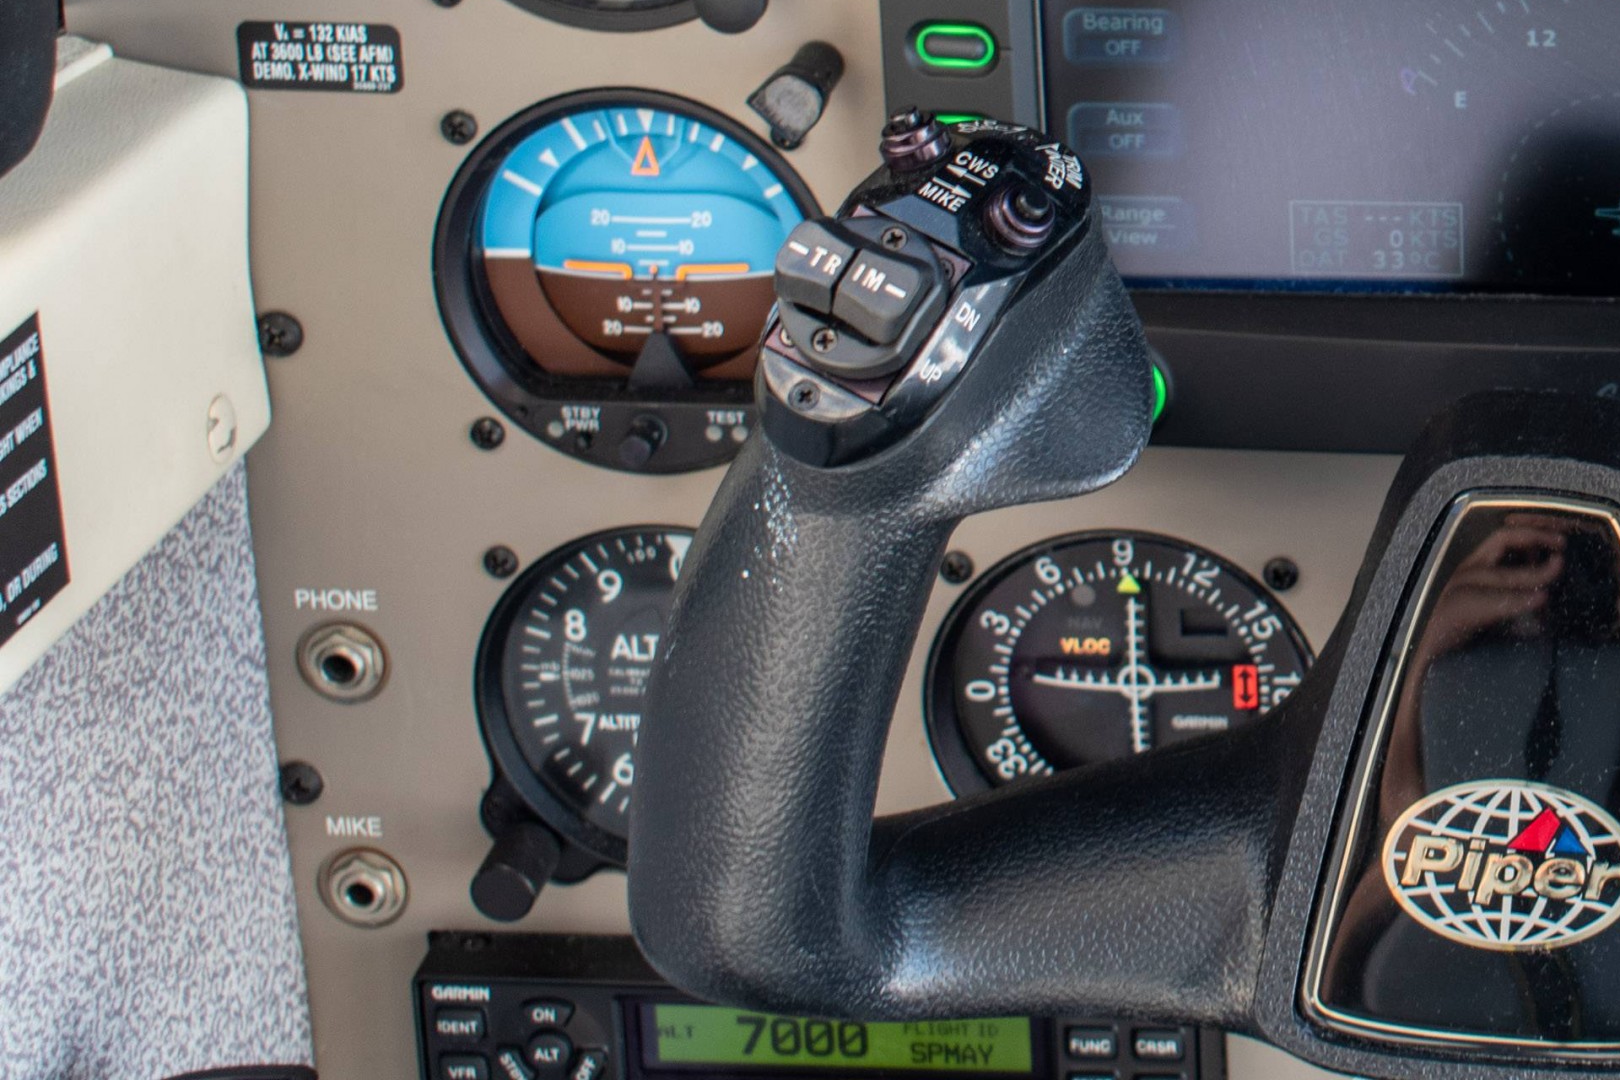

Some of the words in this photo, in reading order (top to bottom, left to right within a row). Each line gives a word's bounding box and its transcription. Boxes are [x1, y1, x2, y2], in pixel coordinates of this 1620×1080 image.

[309, 26, 333, 42] 132
[336, 26, 367, 43] KIAS
[1082, 15, 1163, 34] Bearing
[1106, 41, 1141, 55] OFF
[1527, 31, 1556, 47] 12
[253, 62, 295, 80] DEMO.
[299, 64, 348, 82] X-WIND
[352, 65, 366, 81] 17
[372, 65, 396, 83] KTS
[1107, 111, 1143, 125] Aux
[955, 152, 999, 179] CWS
[919, 181, 966, 212] MIKE
[591, 210, 609, 225] 20
[692, 212, 711, 226] 20
[956, 303, 980, 331] DN
[603, 321, 622, 335] 20
[703, 323, 723, 337] 20
[1112, 540, 1133, 565] 9
[1035, 557, 1061, 584] 6
[1181, 553, 1219, 587] 12
[598, 570, 622, 602] 9
[295, 591, 377, 611] PHONE
[565, 610, 586, 642] 8
[981, 610, 1010, 635] 3
[1244, 601, 1282, 639] 15
[1061, 638, 1111, 653] VLOC
[575, 713, 595, 745] 7
[327, 819, 381, 837] MIKE
[432, 986, 490, 1001] GARMIN
[532, 1008, 555, 1022] ON
[736, 1016, 868, 1058] 7000
[1070, 1039, 1111, 1054] FUNC
[910, 1043, 993, 1065] SPMAY
